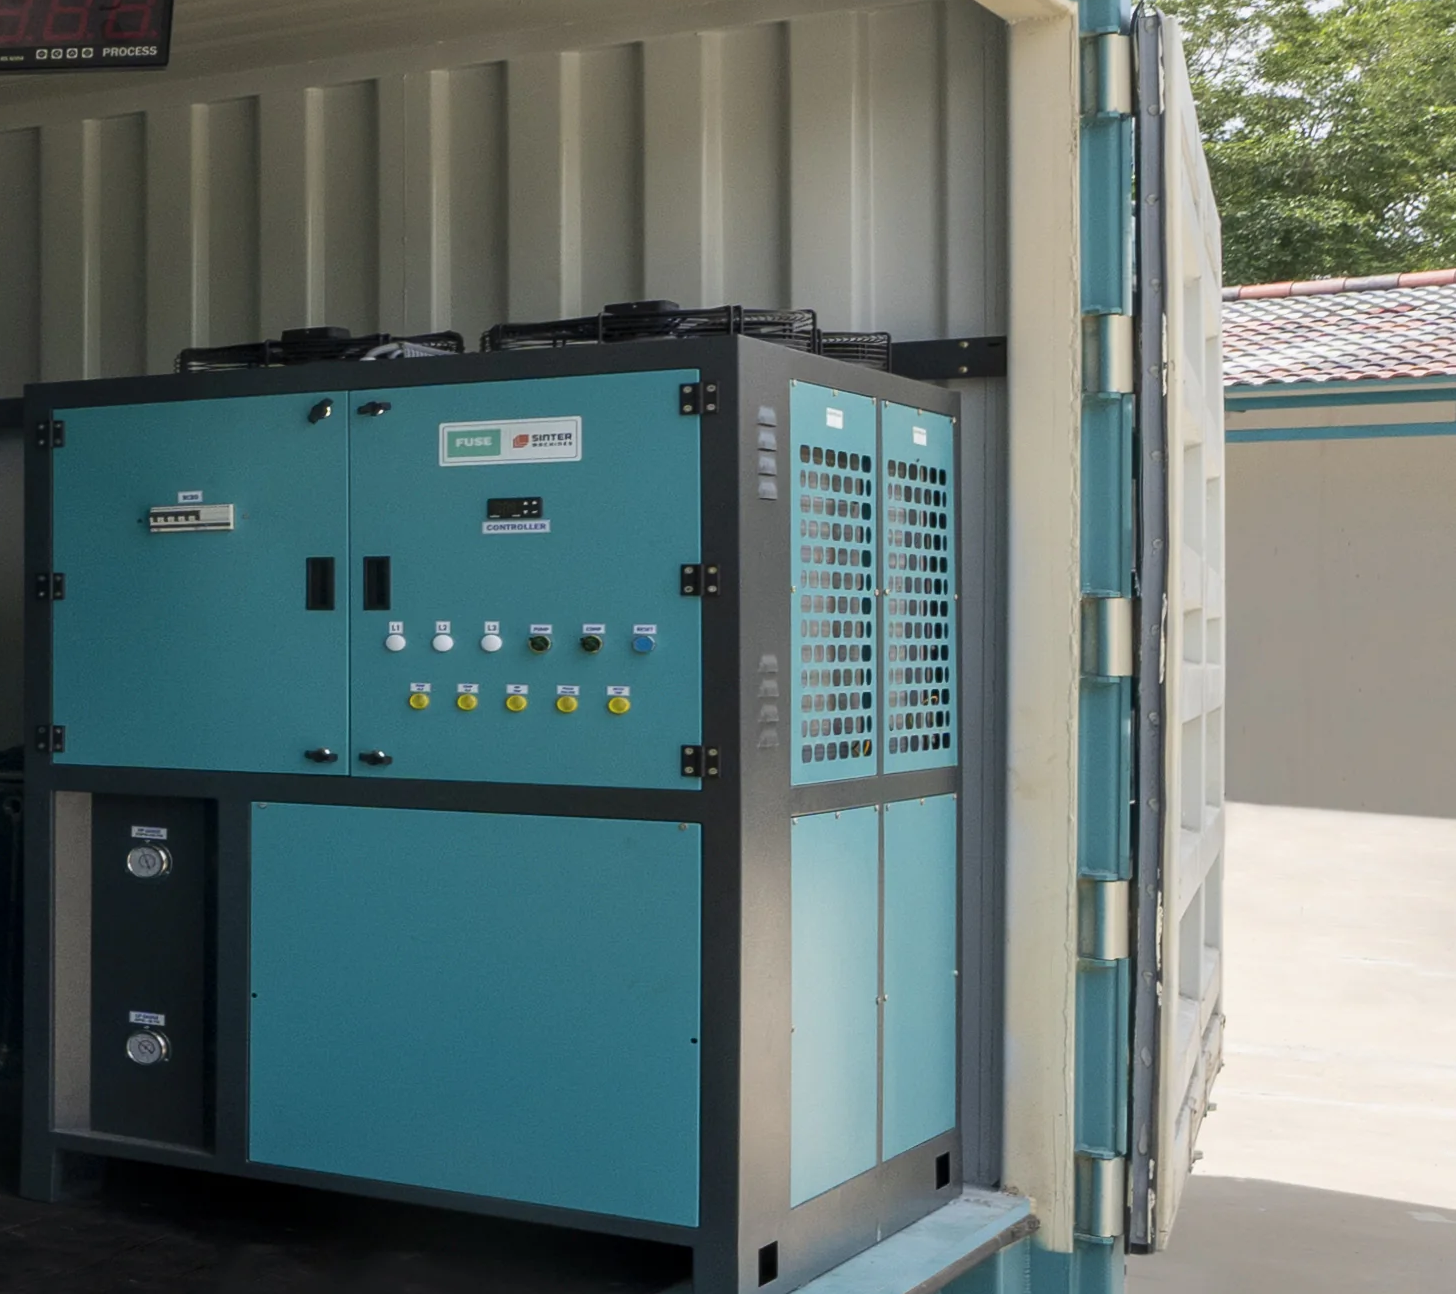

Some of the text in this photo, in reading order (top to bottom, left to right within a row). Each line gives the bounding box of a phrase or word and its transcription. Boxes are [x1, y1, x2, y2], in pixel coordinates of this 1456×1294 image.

[102, 46, 158, 57] PROCESS
[455, 436, 493, 448] FUSE
[531, 432, 573, 442] SINTER
[486, 522, 547, 532] CONTROLLER
